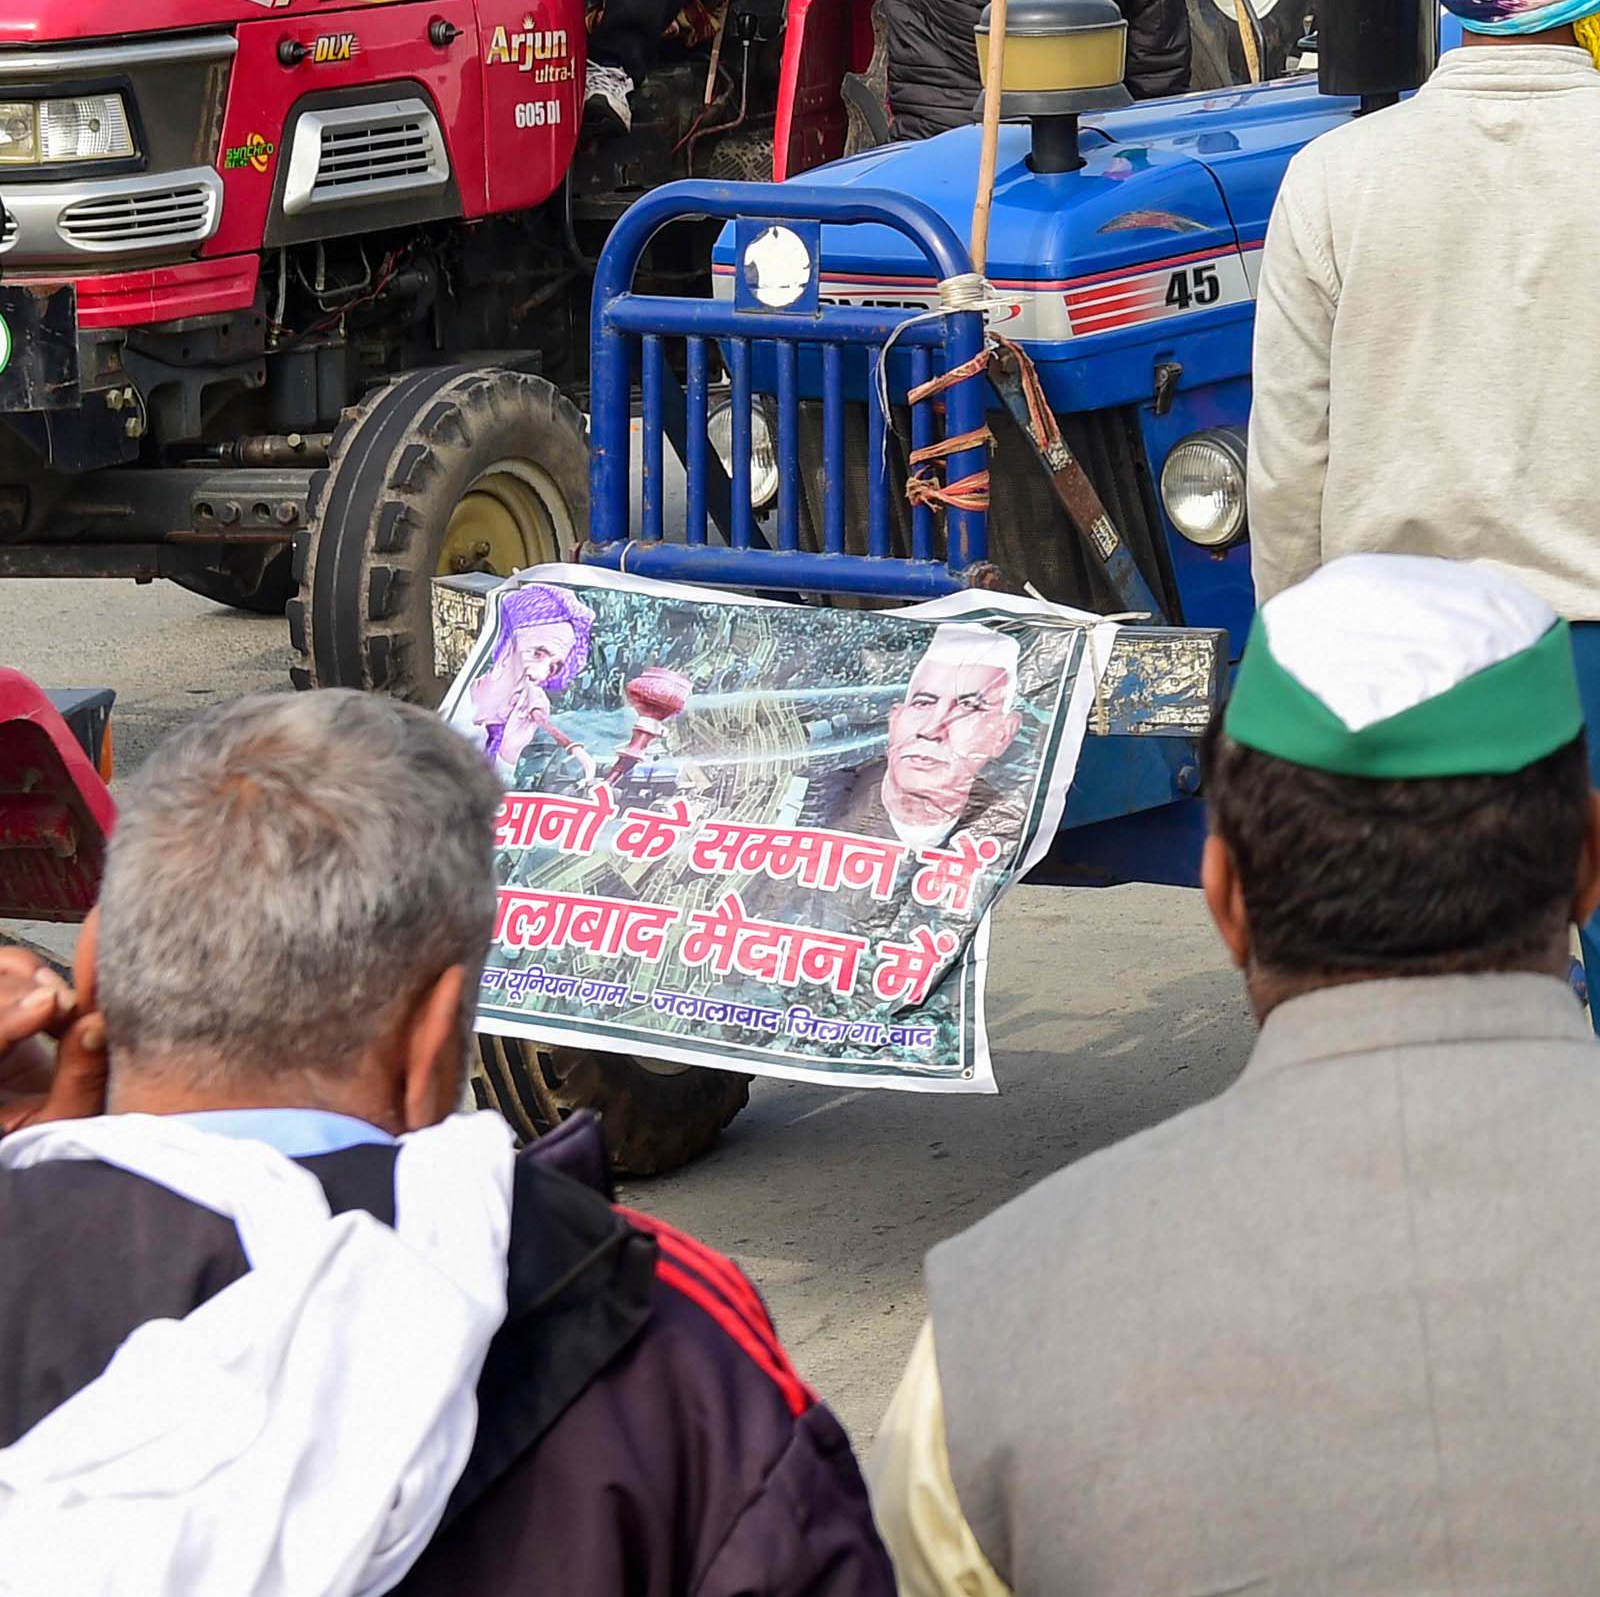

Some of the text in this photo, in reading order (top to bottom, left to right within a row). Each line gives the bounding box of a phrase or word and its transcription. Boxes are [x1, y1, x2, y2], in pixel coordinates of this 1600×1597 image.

[314, 34, 354, 63] DLX
[486, 19, 568, 73] Arjun
[515, 99, 561, 129] 605 DI
[1165, 263, 1220, 311] 45
[495, 786, 1001, 912] सानो के सम्मान में
[490, 887, 961, 1004] ालाबाद मैदान में
[481, 967, 505, 988] न
[507, 968, 579, 1002] यूनियन
[579, 977, 629, 1009] ग्राम
[653, 988, 781, 1032] जलालाबाद
